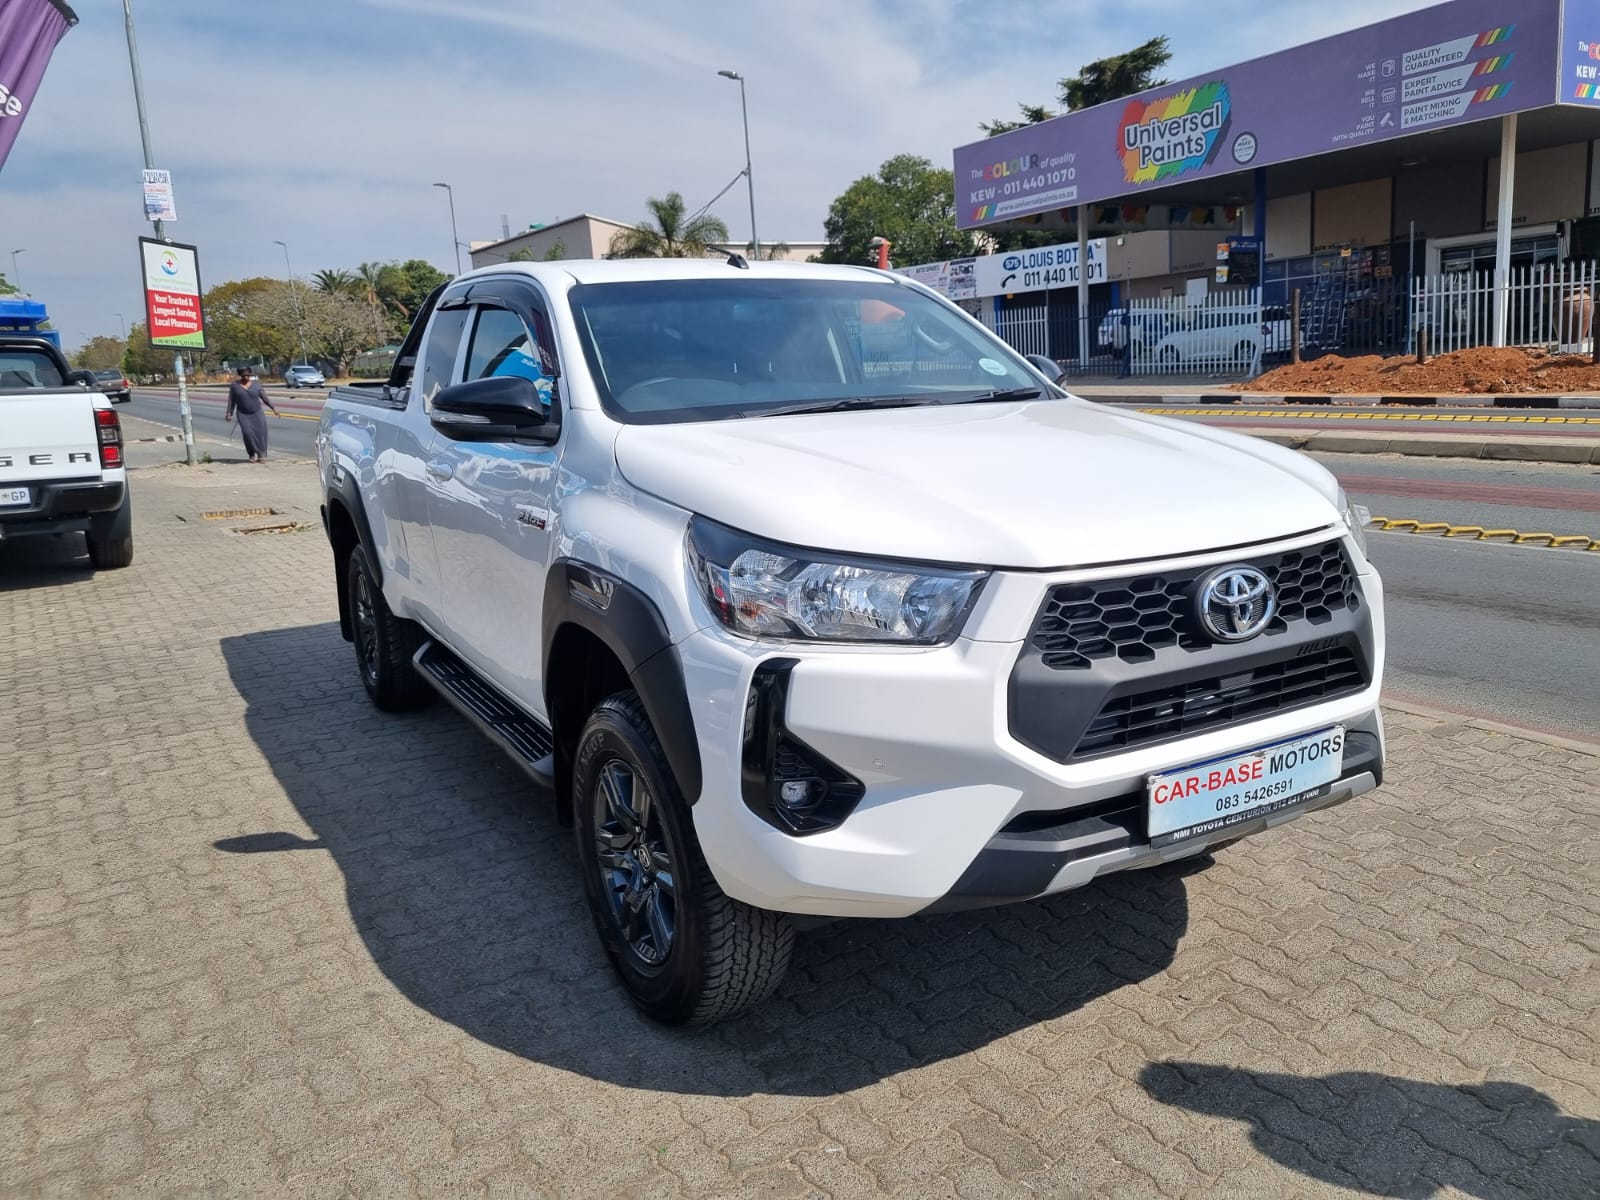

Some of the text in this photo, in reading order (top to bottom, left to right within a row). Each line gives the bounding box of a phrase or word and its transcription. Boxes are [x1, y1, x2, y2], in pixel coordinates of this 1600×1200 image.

[1579, 41, 1588, 52] The
[1405, 48, 1440, 63] QUALITY
[1405, 51, 1463, 72] GUARANTEED
[1358, 70, 1376, 79] MAKE
[1576, 65, 1597, 79] KEW
[1405, 76, 1437, 90] EXPERT
[1405, 78, 1463, 98] PAINT ADVICE
[1361, 96, 1376, 104] SELL
[1404, 97, 1461, 117] PAINT MIXING
[1362, 115, 1375, 123] YOU
[1411, 107, 1455, 123] MATCHING
[1126, 104, 1220, 148] Universal
[1356, 121, 1375, 130] PAINT
[1332, 128, 1375, 142] WITH QUALITY
[1140, 135, 1204, 167] Paints
[971, 151, 1076, 181] The COLOUR of quality
[970, 187, 996, 203] KEW
[1003, 181, 1020, 196] 011
[1023, 175, 1045, 191] 440
[1047, 167, 1077, 185] 1070
[1022, 251, 1054, 269] LOUIS
[1056, 245, 1094, 265] BOTA
[1024, 270, 1040, 287] 011
[1043, 267, 1066, 285] 440
[154, 294, 194, 307] Your Trusted &
[153, 305, 197, 320] Longest Serving
[155, 317, 198, 331] Local Pharmacy
[11, 491, 26, 501] GP
[1154, 735, 1342, 804] CAR-BASE MOTORS
[1216, 778, 1293, 811] 083 5426591
[1173, 829, 1190, 840] NMI
[1192, 819, 1224, 834] TOYOTA
[1226, 804, 1271, 824] CENTURION
